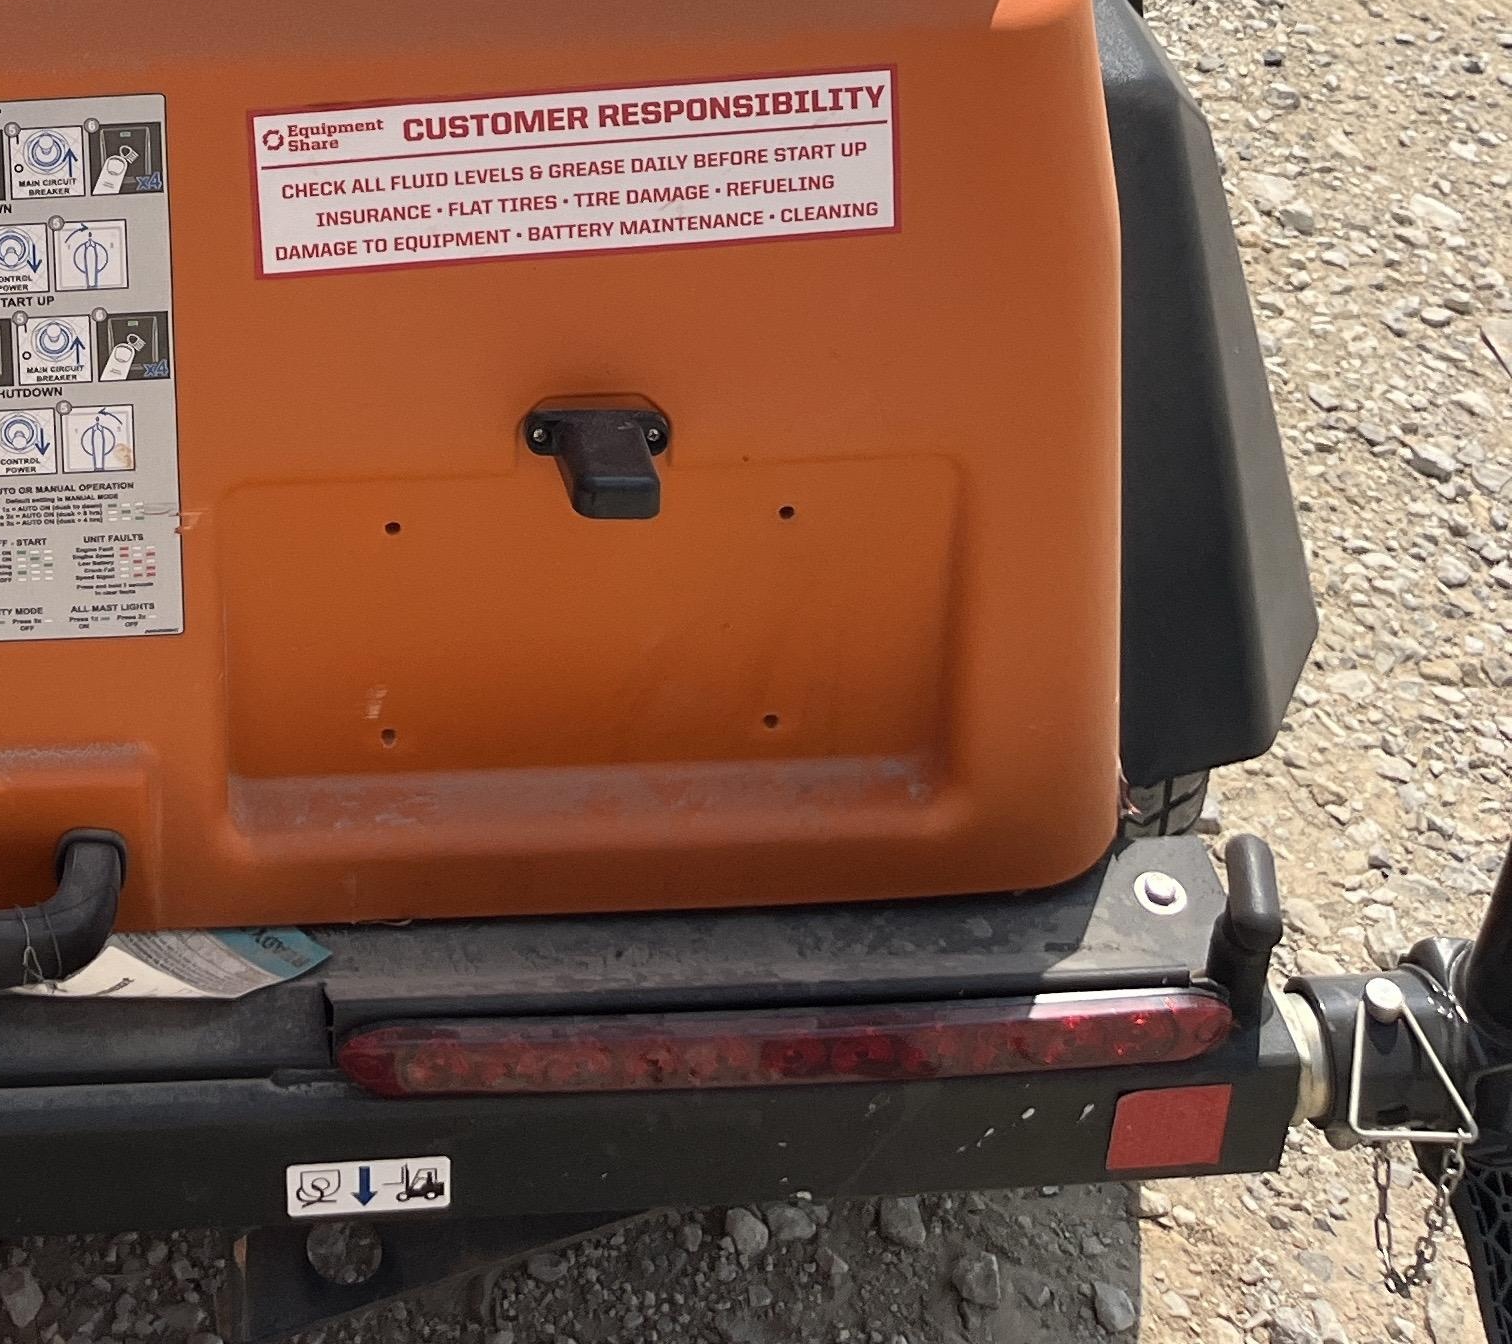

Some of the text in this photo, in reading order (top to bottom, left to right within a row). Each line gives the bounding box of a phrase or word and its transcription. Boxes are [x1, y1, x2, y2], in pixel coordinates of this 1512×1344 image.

[403, 86, 884, 141] CUSTOMER RESPONSIBILITY
[287, 119, 383, 138] Equipment
[287, 134, 338, 152] Share
[281, 141, 866, 199] CHECK ALL FLUID LEVELS & GREASE DAILY BEFORE START UP
[18, 177, 76, 187] MAIN CIRCUIT
[28, 187, 69, 196] BREAKER
[315, 174, 834, 227] INSURANCE FLAT TIRES TIRE DAMAGE REFUELING
[275, 201, 878, 260] DAMAGE TO EQUIPMENT BATTERY MAINTENANCE CLEANING
[37, 295, 54, 305] UP
[5, 466, 39, 474] POWER
[18, 486, 32, 494] OR
[35, 484, 75, 493] MANUAL
[78, 481, 133, 491] OPERATION
[16, 537, 46, 546] START
[83, 533, 143, 543] UNIT FAULTS
[15, 606, 42, 614] MODE
[70, 602, 154, 613] ALL MAST LIGHTS
